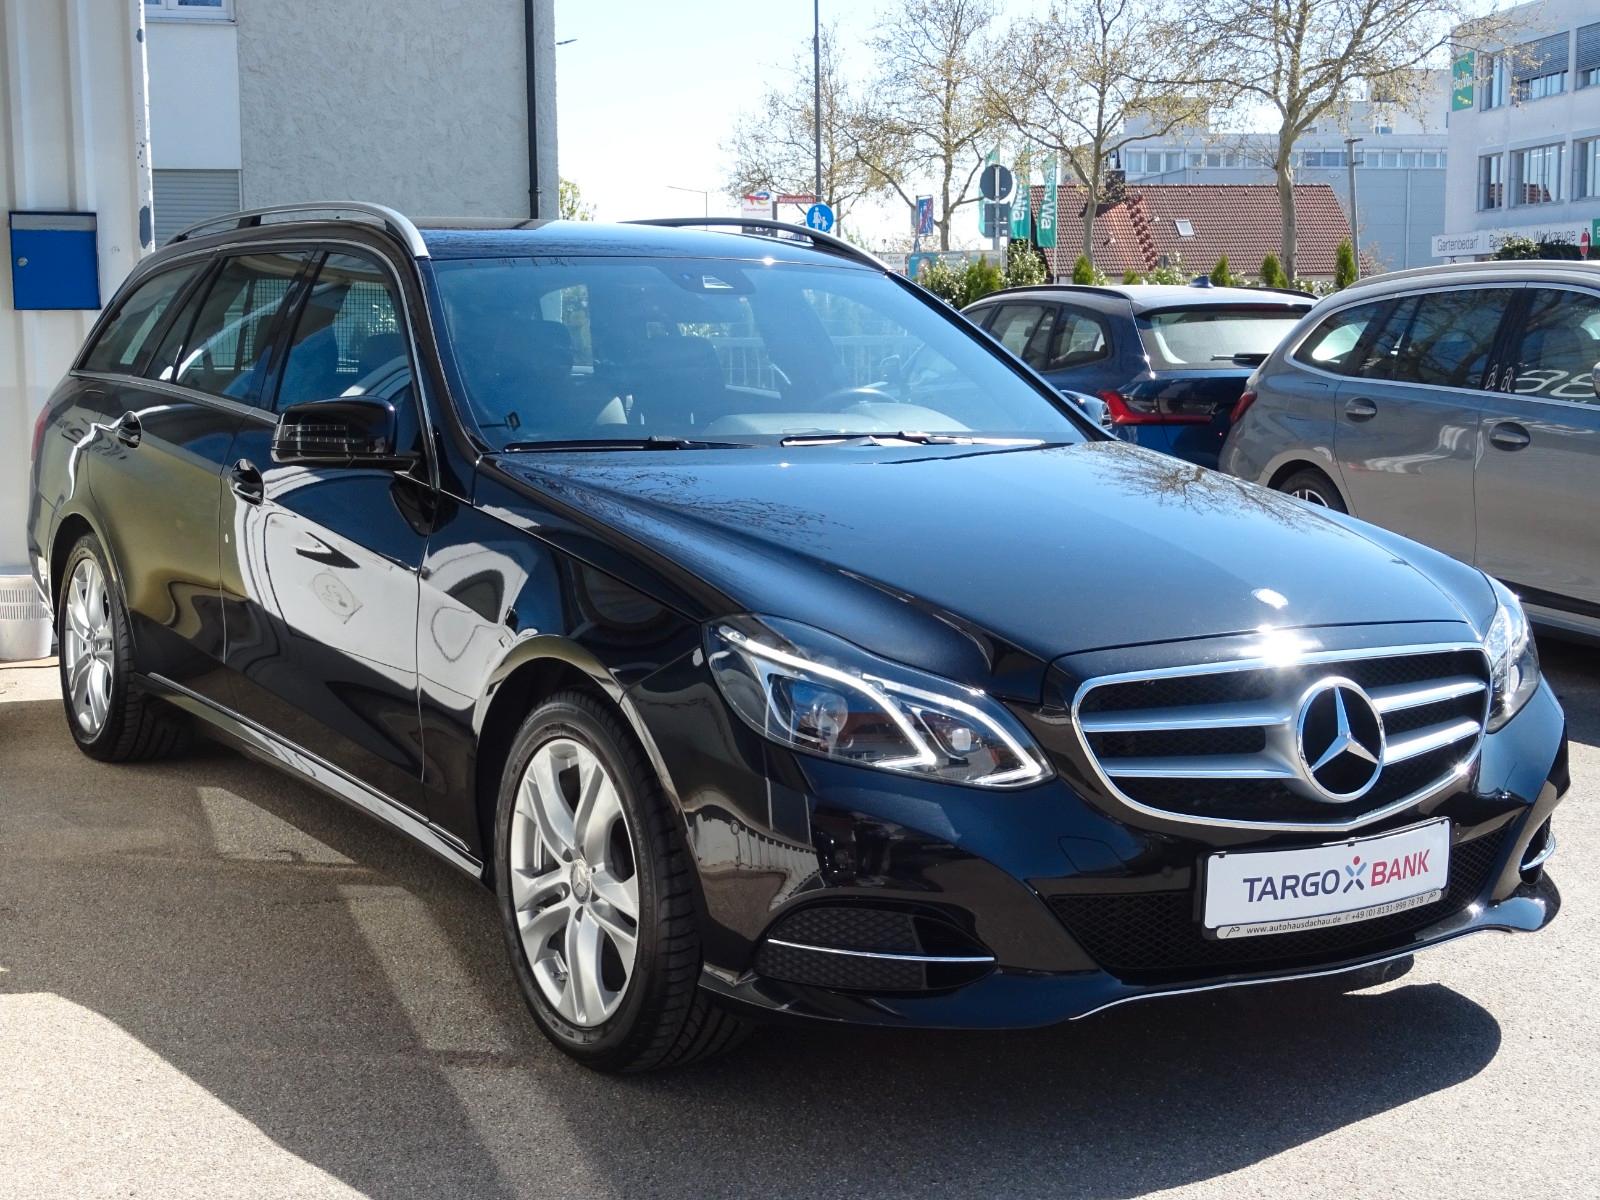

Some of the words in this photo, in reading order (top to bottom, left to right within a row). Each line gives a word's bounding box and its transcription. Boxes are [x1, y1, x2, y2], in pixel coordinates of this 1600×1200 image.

[1437, 235, 1479, 252] Gartenbedarf
[1243, 869, 1340, 902] TARGO
[1371, 849, 1430, 887] BANK
[1246, 915, 1341, 934] www.autohausdachau.de
[1352, 910, 1364, 920] +49
[1365, 908, 1376, 918] (0)
